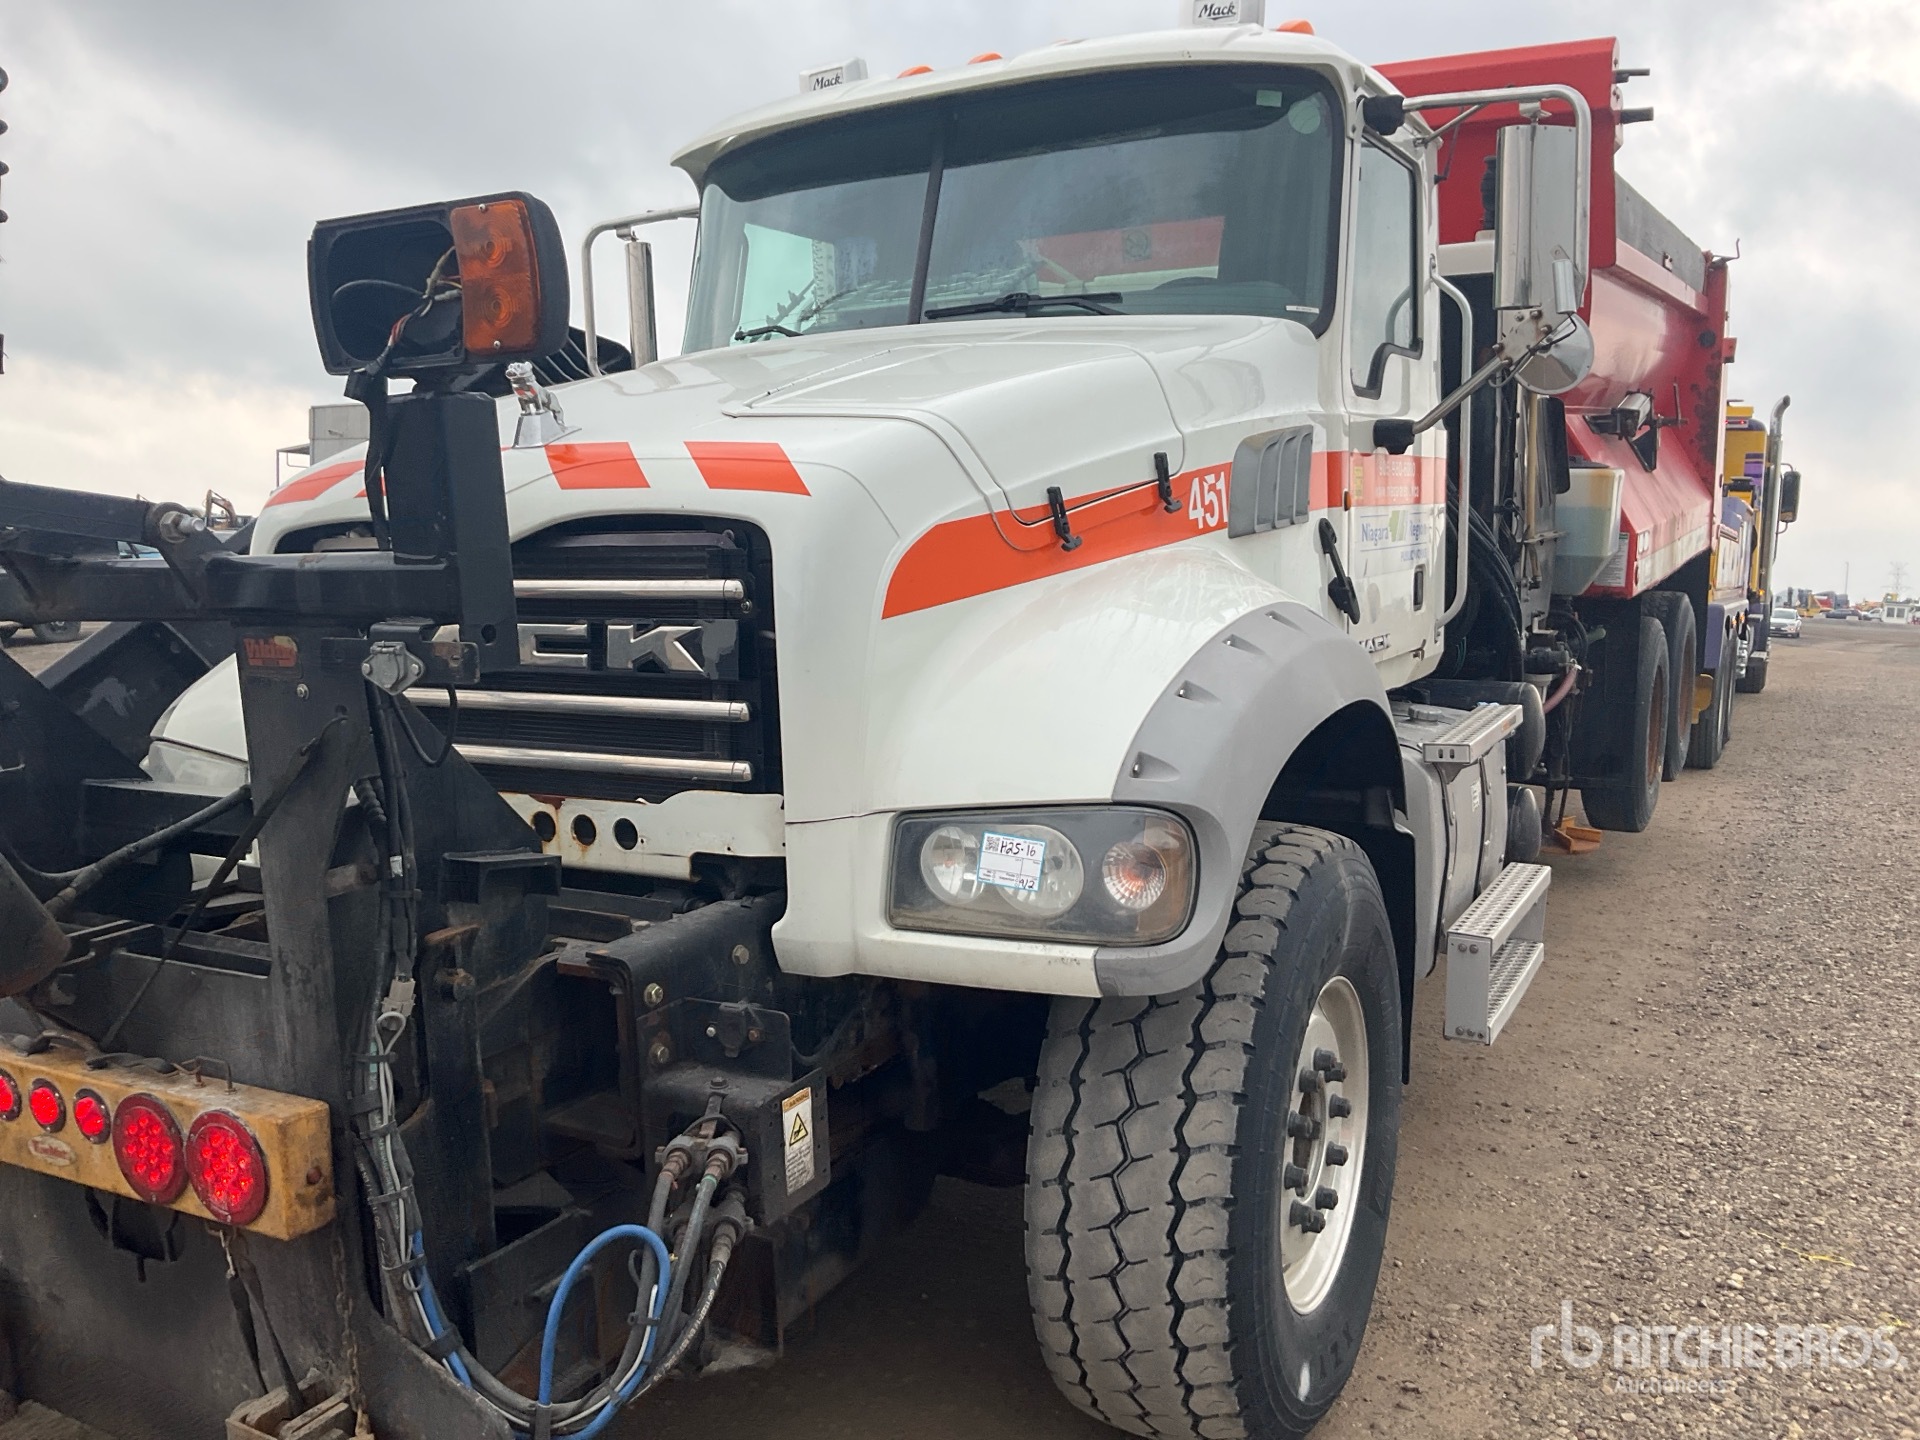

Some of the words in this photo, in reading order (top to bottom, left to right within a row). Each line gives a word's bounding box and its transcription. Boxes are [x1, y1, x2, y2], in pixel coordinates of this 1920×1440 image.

[1198, 1, 1236, 20] Mack
[813, 72, 842, 90] Mack
[1188, 471, 1229, 529] 451
[1361, 522, 1389, 546] Niagara
